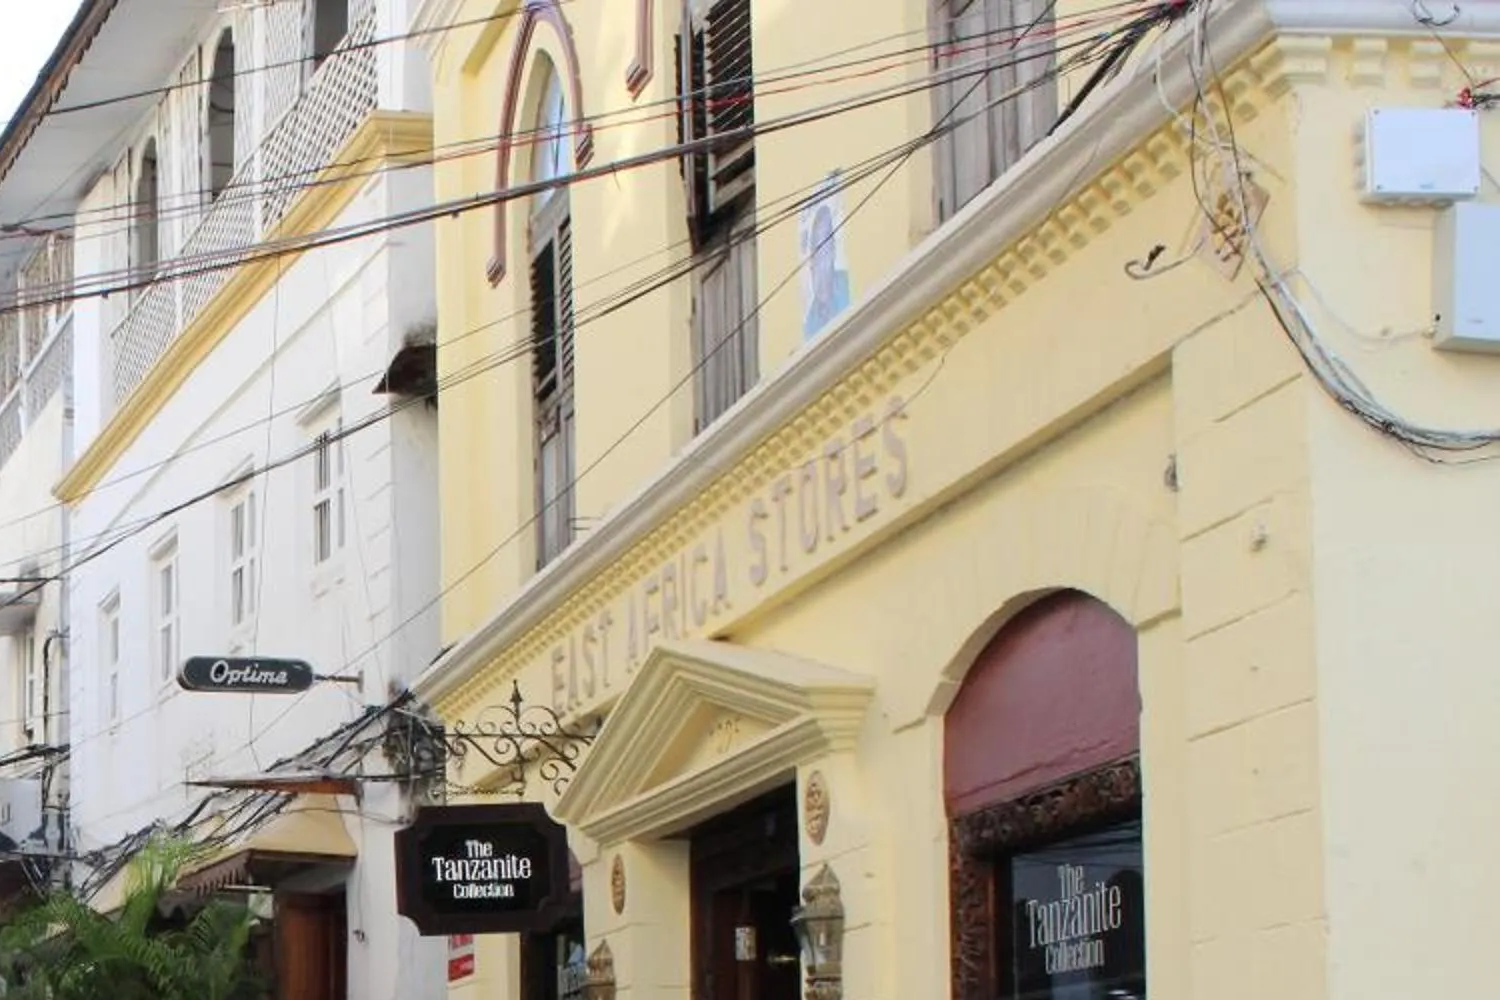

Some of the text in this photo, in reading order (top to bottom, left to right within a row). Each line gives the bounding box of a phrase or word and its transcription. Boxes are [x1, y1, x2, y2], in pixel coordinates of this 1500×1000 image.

[551, 397, 909, 719] EAST AFRICA STORES
[209, 659, 289, 685] Optima
[465, 839, 493, 858] The
[432, 854, 532, 881] Tanzanite
[1057, 863, 1086, 900] The
[453, 882, 514, 899] Collection
[1025, 881, 1122, 949] Tanzanite
[1045, 938, 1105, 975] Collection
